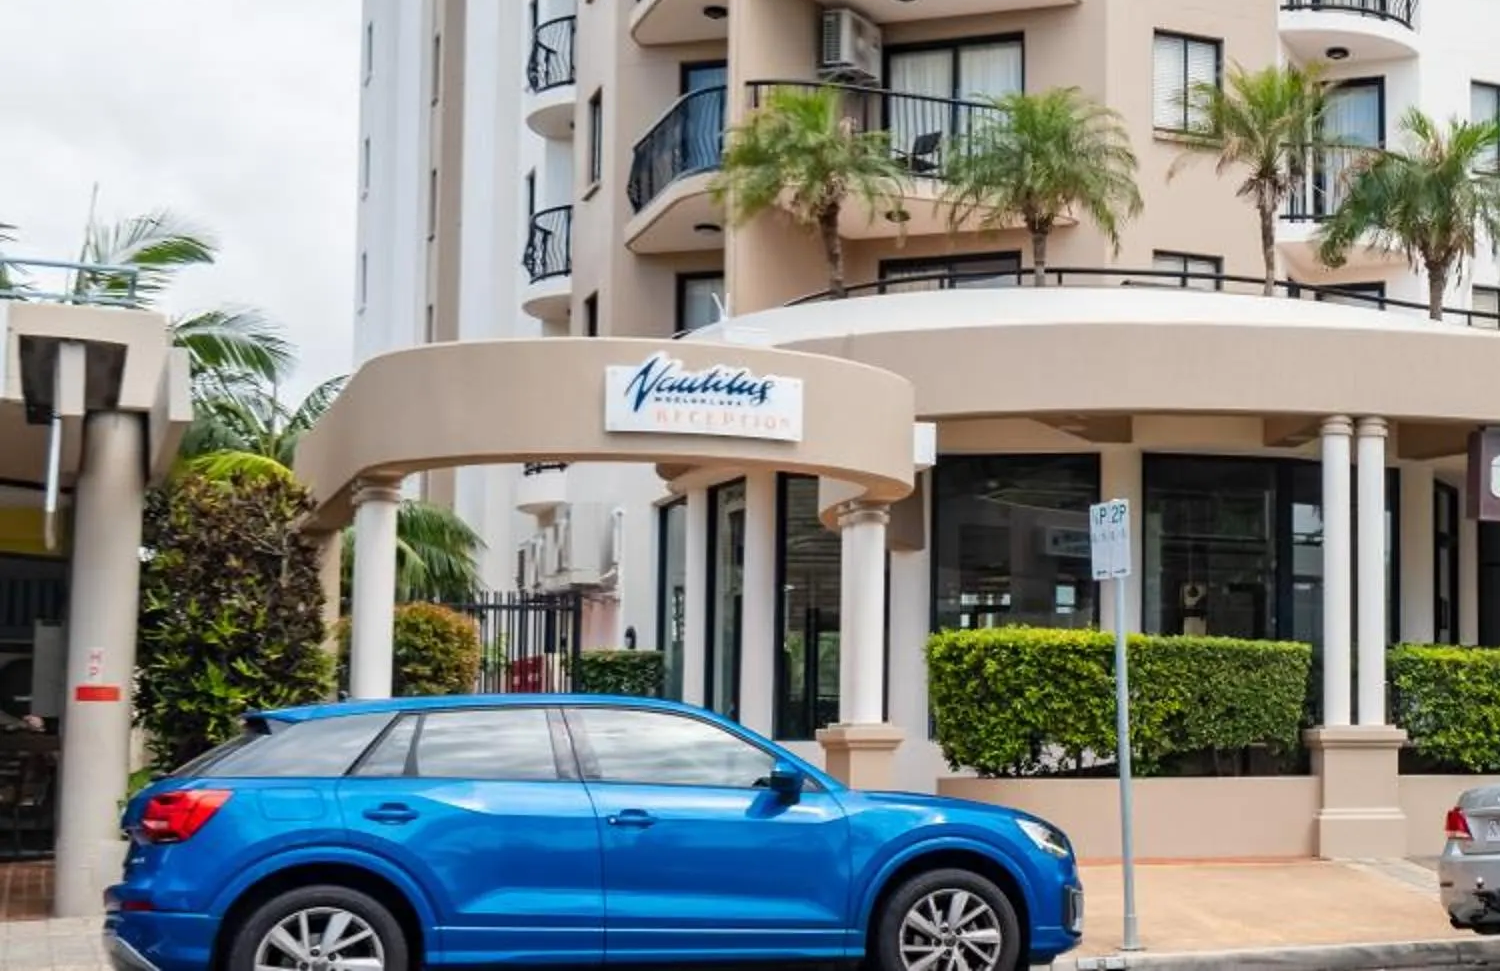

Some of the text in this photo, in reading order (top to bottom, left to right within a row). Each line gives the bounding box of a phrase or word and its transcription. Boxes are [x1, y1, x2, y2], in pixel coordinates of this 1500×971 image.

[624, 356, 776, 413] Nautilus
[656, 408, 790, 431] RECEPTION
[1111, 503, 1127, 524] 2P
